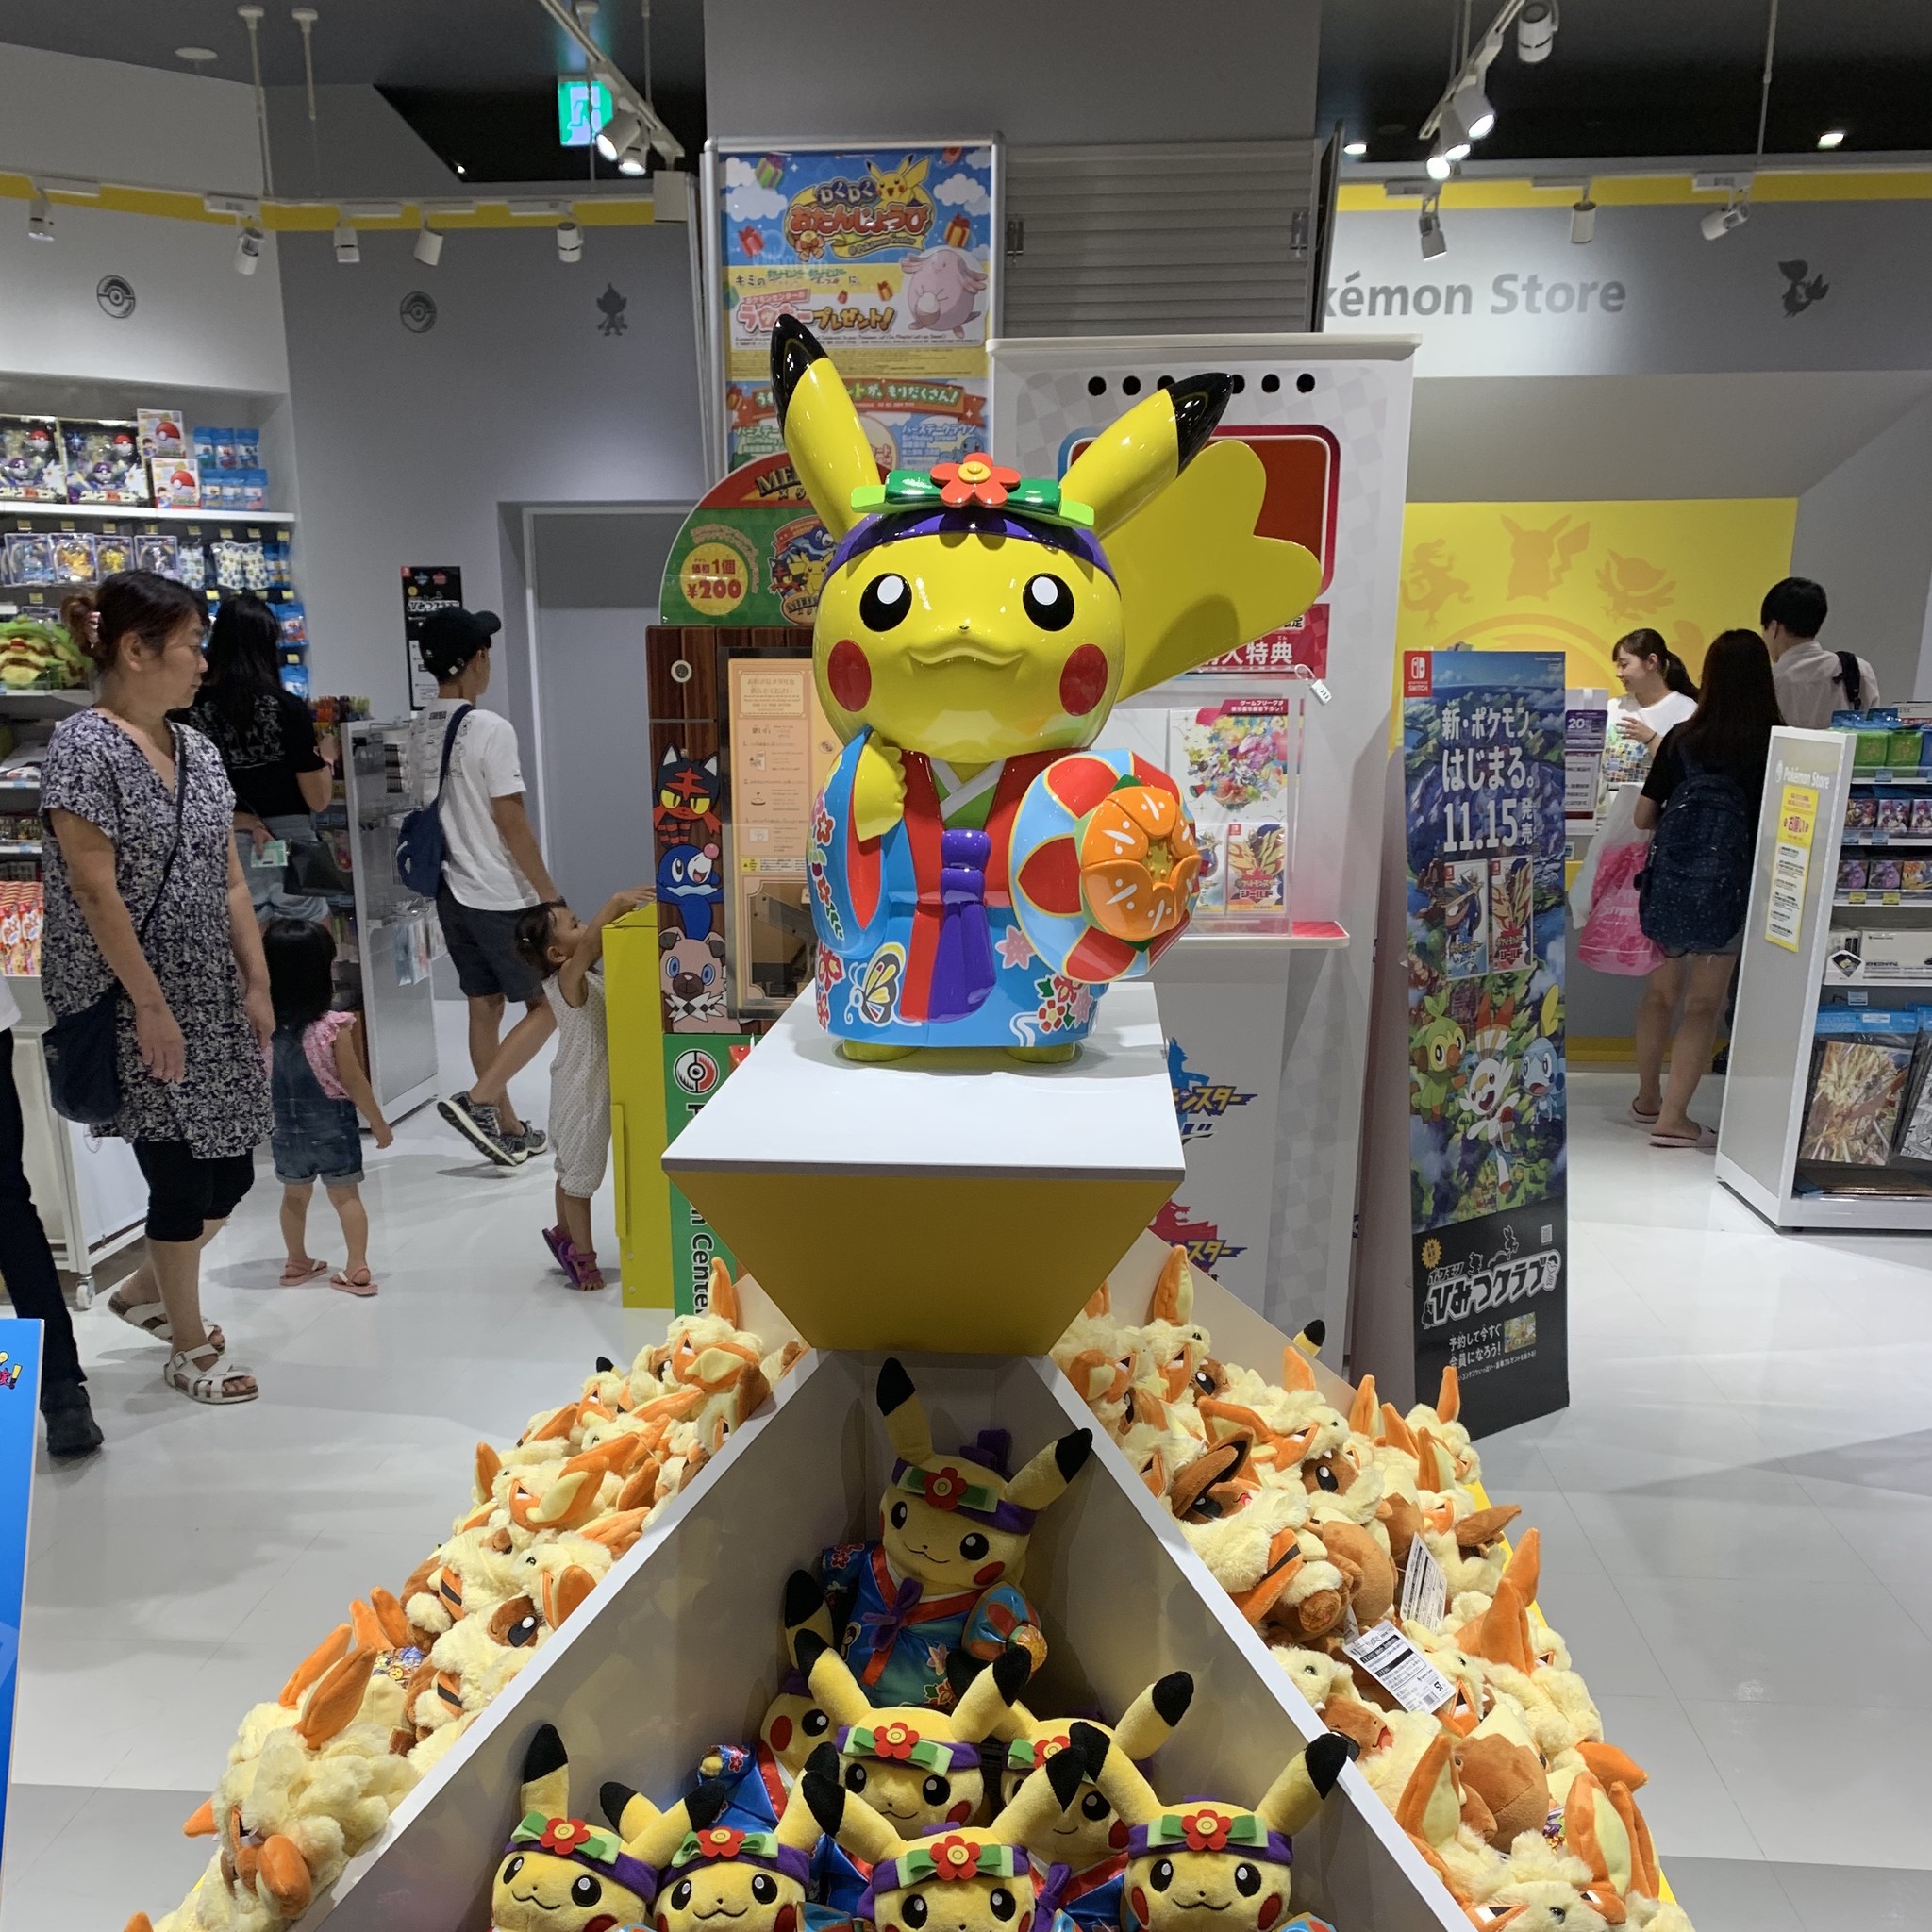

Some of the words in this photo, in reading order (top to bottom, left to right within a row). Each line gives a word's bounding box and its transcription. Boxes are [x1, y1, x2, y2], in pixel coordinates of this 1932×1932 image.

[818, 180, 874, 207] わくわく
[791, 204, 929, 235] おたんじょうび
[1491, 273, 1627, 314] Store
[888, 385, 959, 404] もりだくさん!
[687, 578, 742, 600] ¥200
[1205, 641, 1293, 666] 入特典
[1441, 706, 1535, 743] 新・ポケモン、
[1568, 718, 1585, 729] 20
[1442, 745, 1534, 793] はじまる。
[1443, 798, 1518, 853] 11.15
[1521, 797, 1533, 846] 発売
[691, 1232, 714, 1314] Cente
[1429, 1256, 1549, 1323] ひみつクラブ
[1448, 1323, 1503, 1352] 予約して今すぐ
[1449, 1341, 1501, 1368] 会員になろう!
